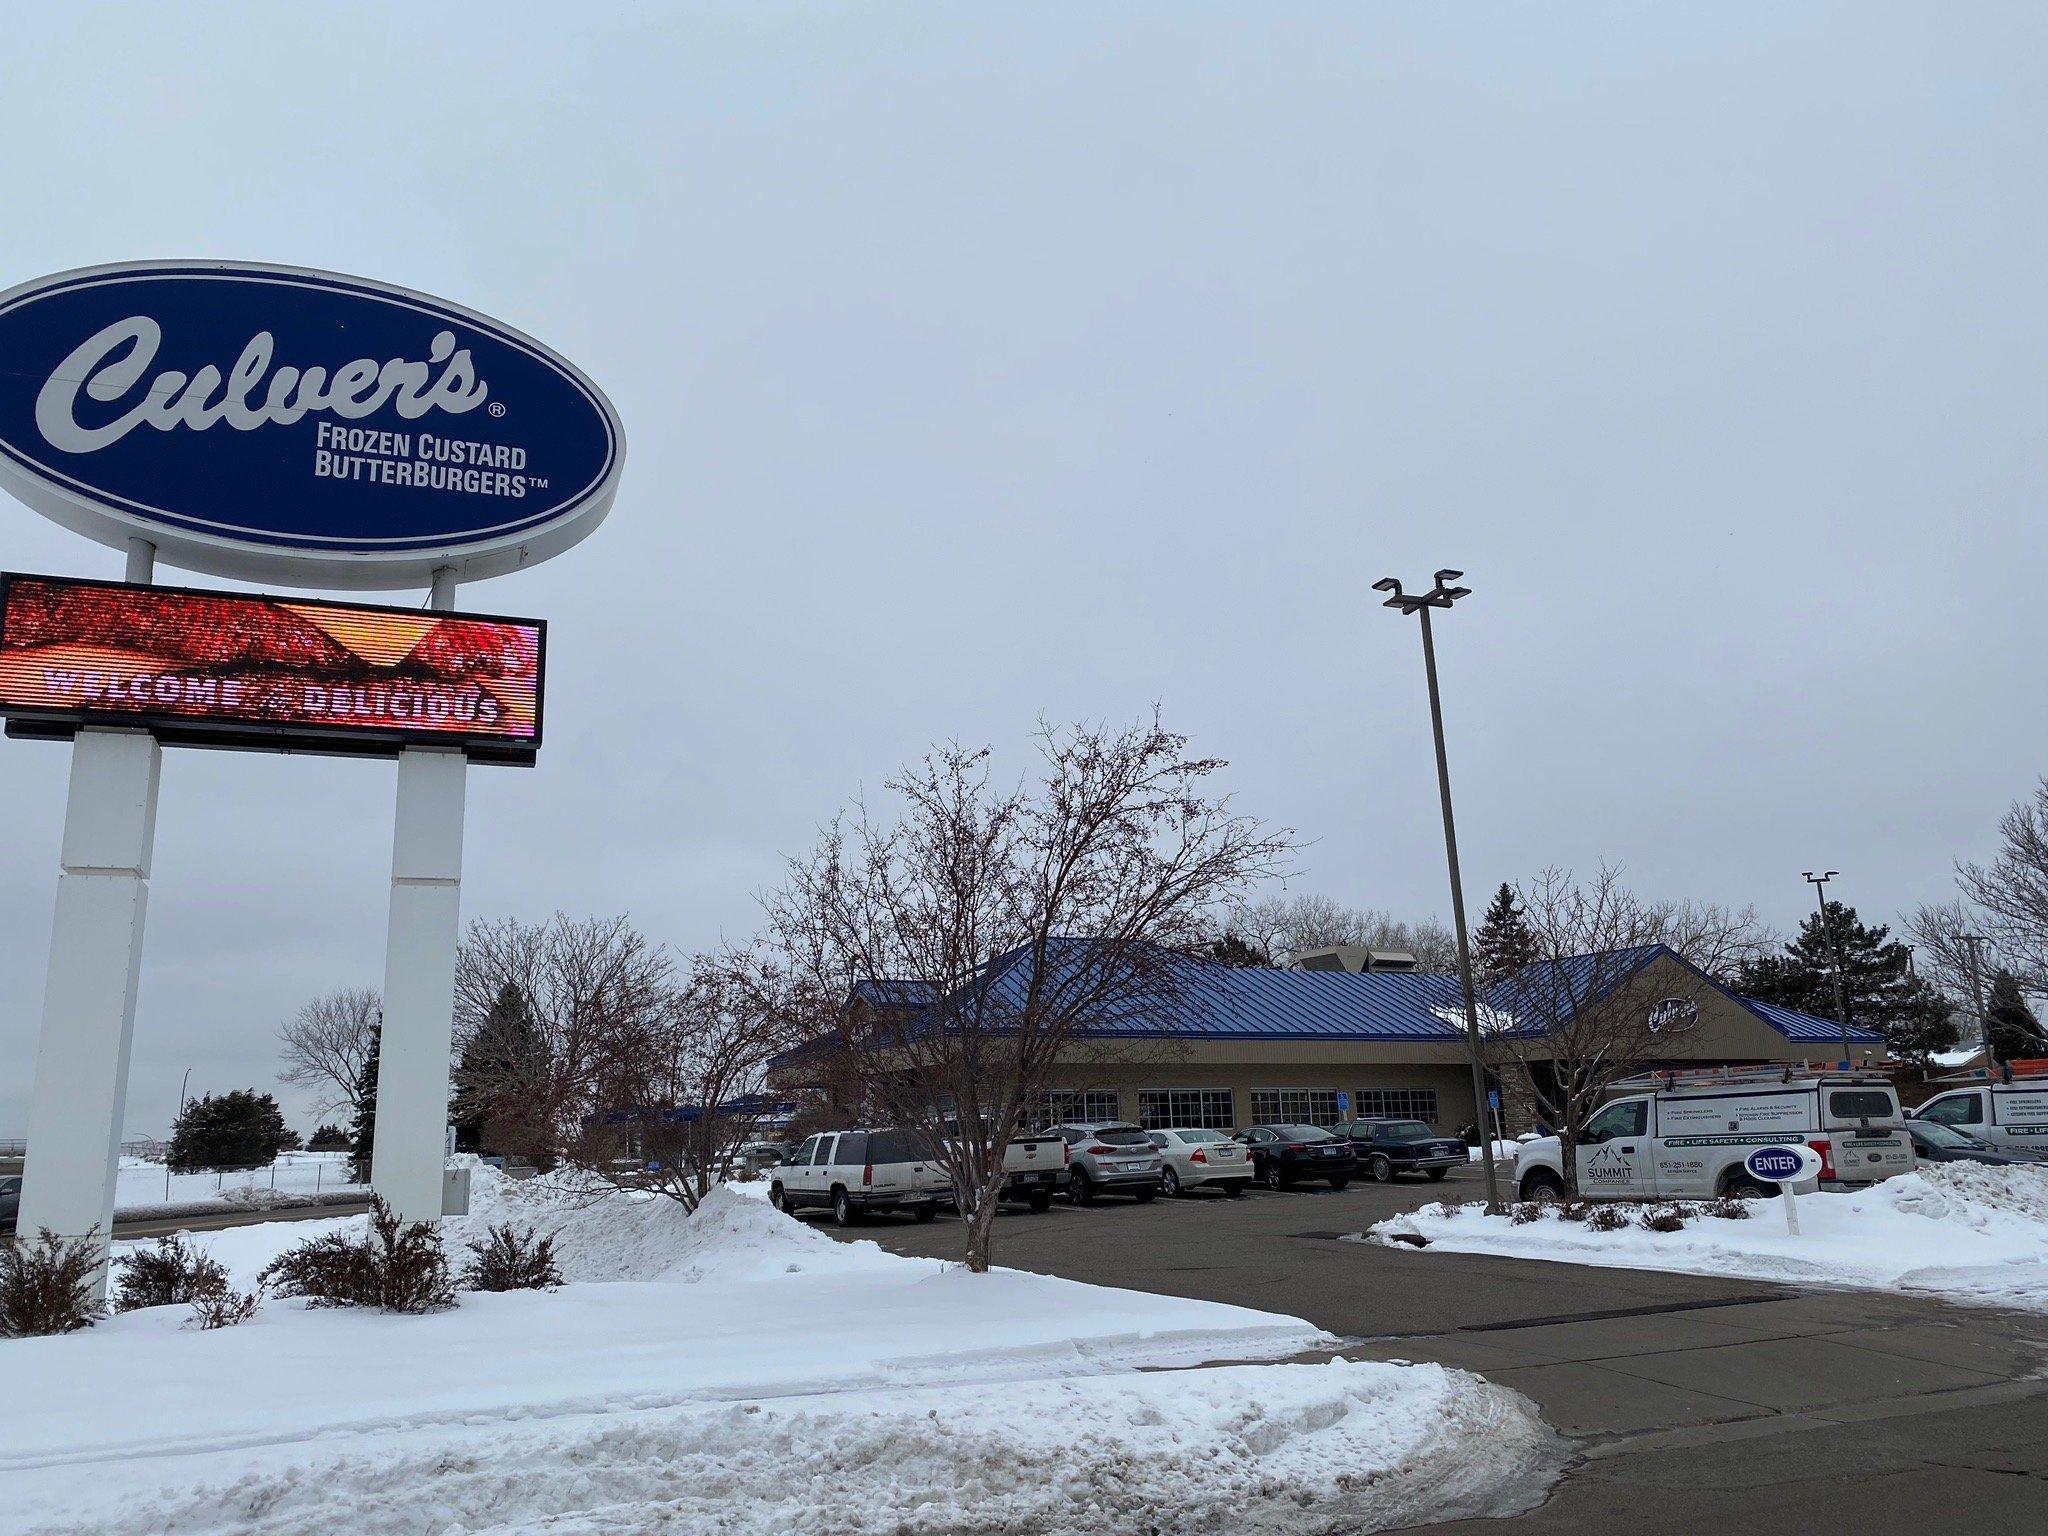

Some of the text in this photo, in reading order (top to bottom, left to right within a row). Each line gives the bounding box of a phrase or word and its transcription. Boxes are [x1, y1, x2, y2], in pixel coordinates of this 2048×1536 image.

[35, 315, 488, 454] Culver's
[316, 421, 527, 470] FROZEN CUSTARD
[314, 449, 527, 498] BUTTERBURGERS
[42, 668, 242, 706] WELCOME
[302, 685, 499, 725] DELICIOUS
[1745, 1135, 1799, 1143] CONSULTING
[1754, 1156, 1797, 1171] ENTER
[1587, 1167, 1632, 1178] SUMMIT
